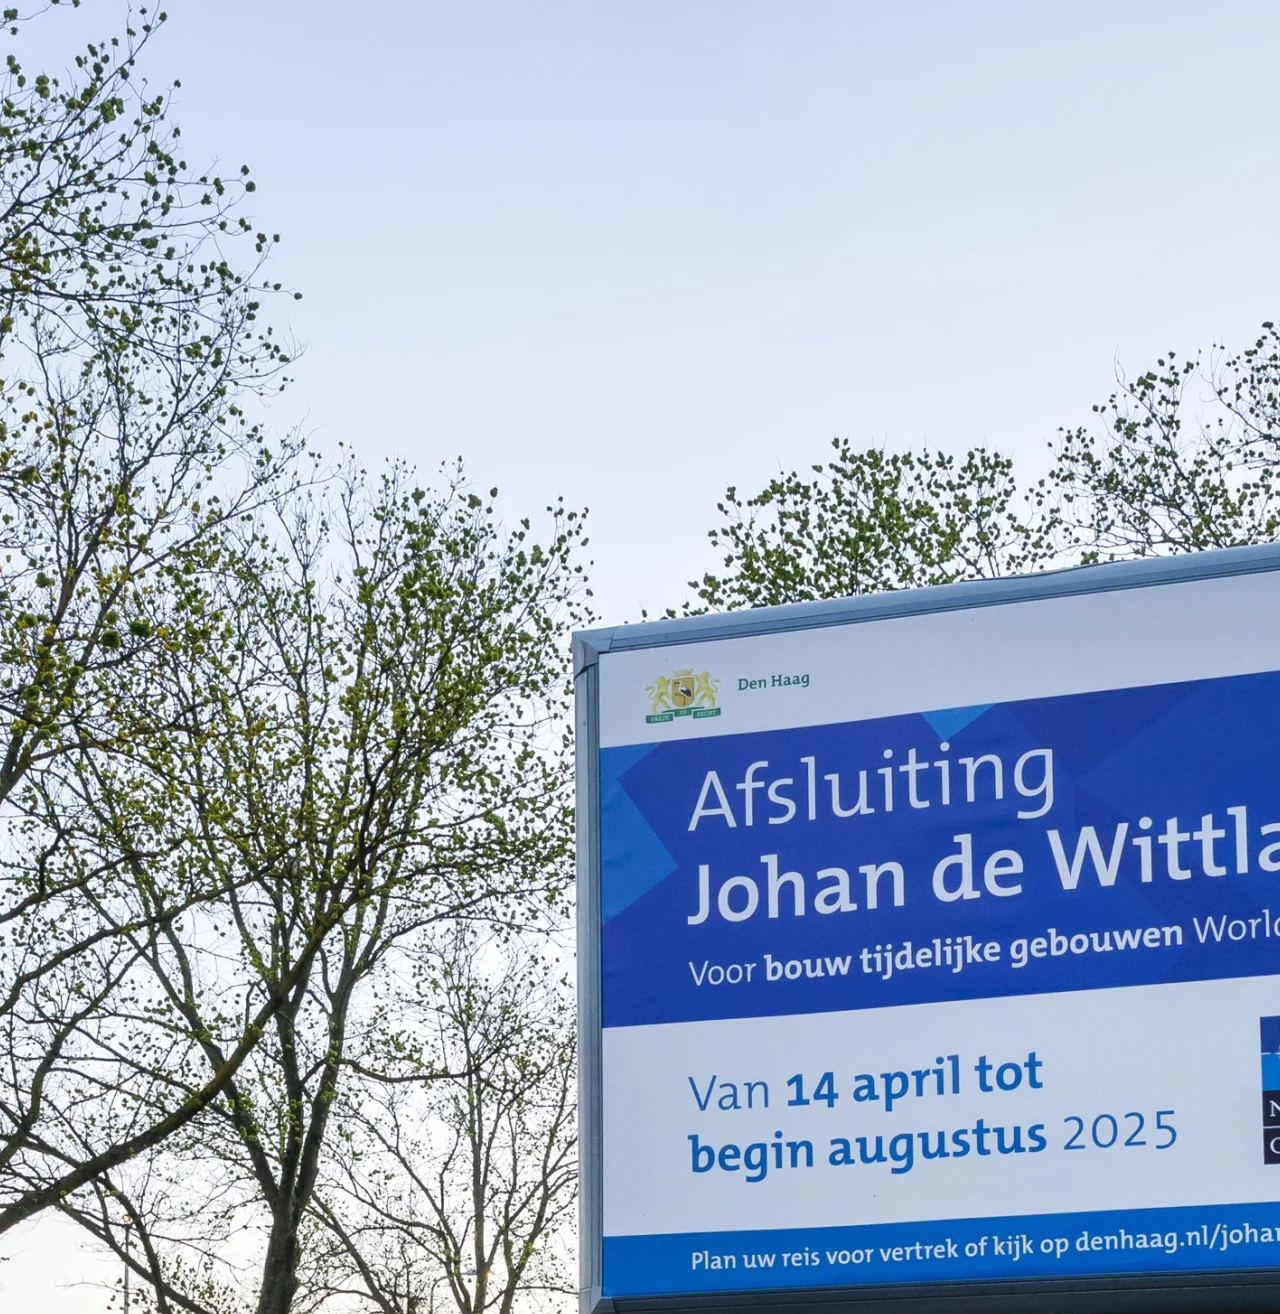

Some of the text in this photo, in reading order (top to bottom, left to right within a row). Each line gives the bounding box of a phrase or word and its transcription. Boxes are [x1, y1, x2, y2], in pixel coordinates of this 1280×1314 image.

[737, 674, 810, 691] Den Haag
[688, 741, 1054, 831] Afsluiting
[687, 854, 905, 926] Johan
[932, 833, 1024, 902] de
[689, 960, 757, 986] Voor
[764, 954, 852, 982] bouw
[860, 936, 1001, 980] tijdelijke
[1009, 925, 1183, 968] gebouwen
[688, 1052, 1044, 1112] Van 14 april tot
[688, 1110, 1178, 1183] begin augustus 2025
[691, 1250, 737, 1270] Plan
[742, 1252, 776, 1268] uw
[782, 1247, 821, 1267] reis
[826, 1249, 875, 1265] voor
[880, 1238, 959, 1262] vertrek
[964, 1237, 988, 1257] of
[992, 1234, 1034, 1262] kijk
[1040, 1237, 1070, 1258] op
